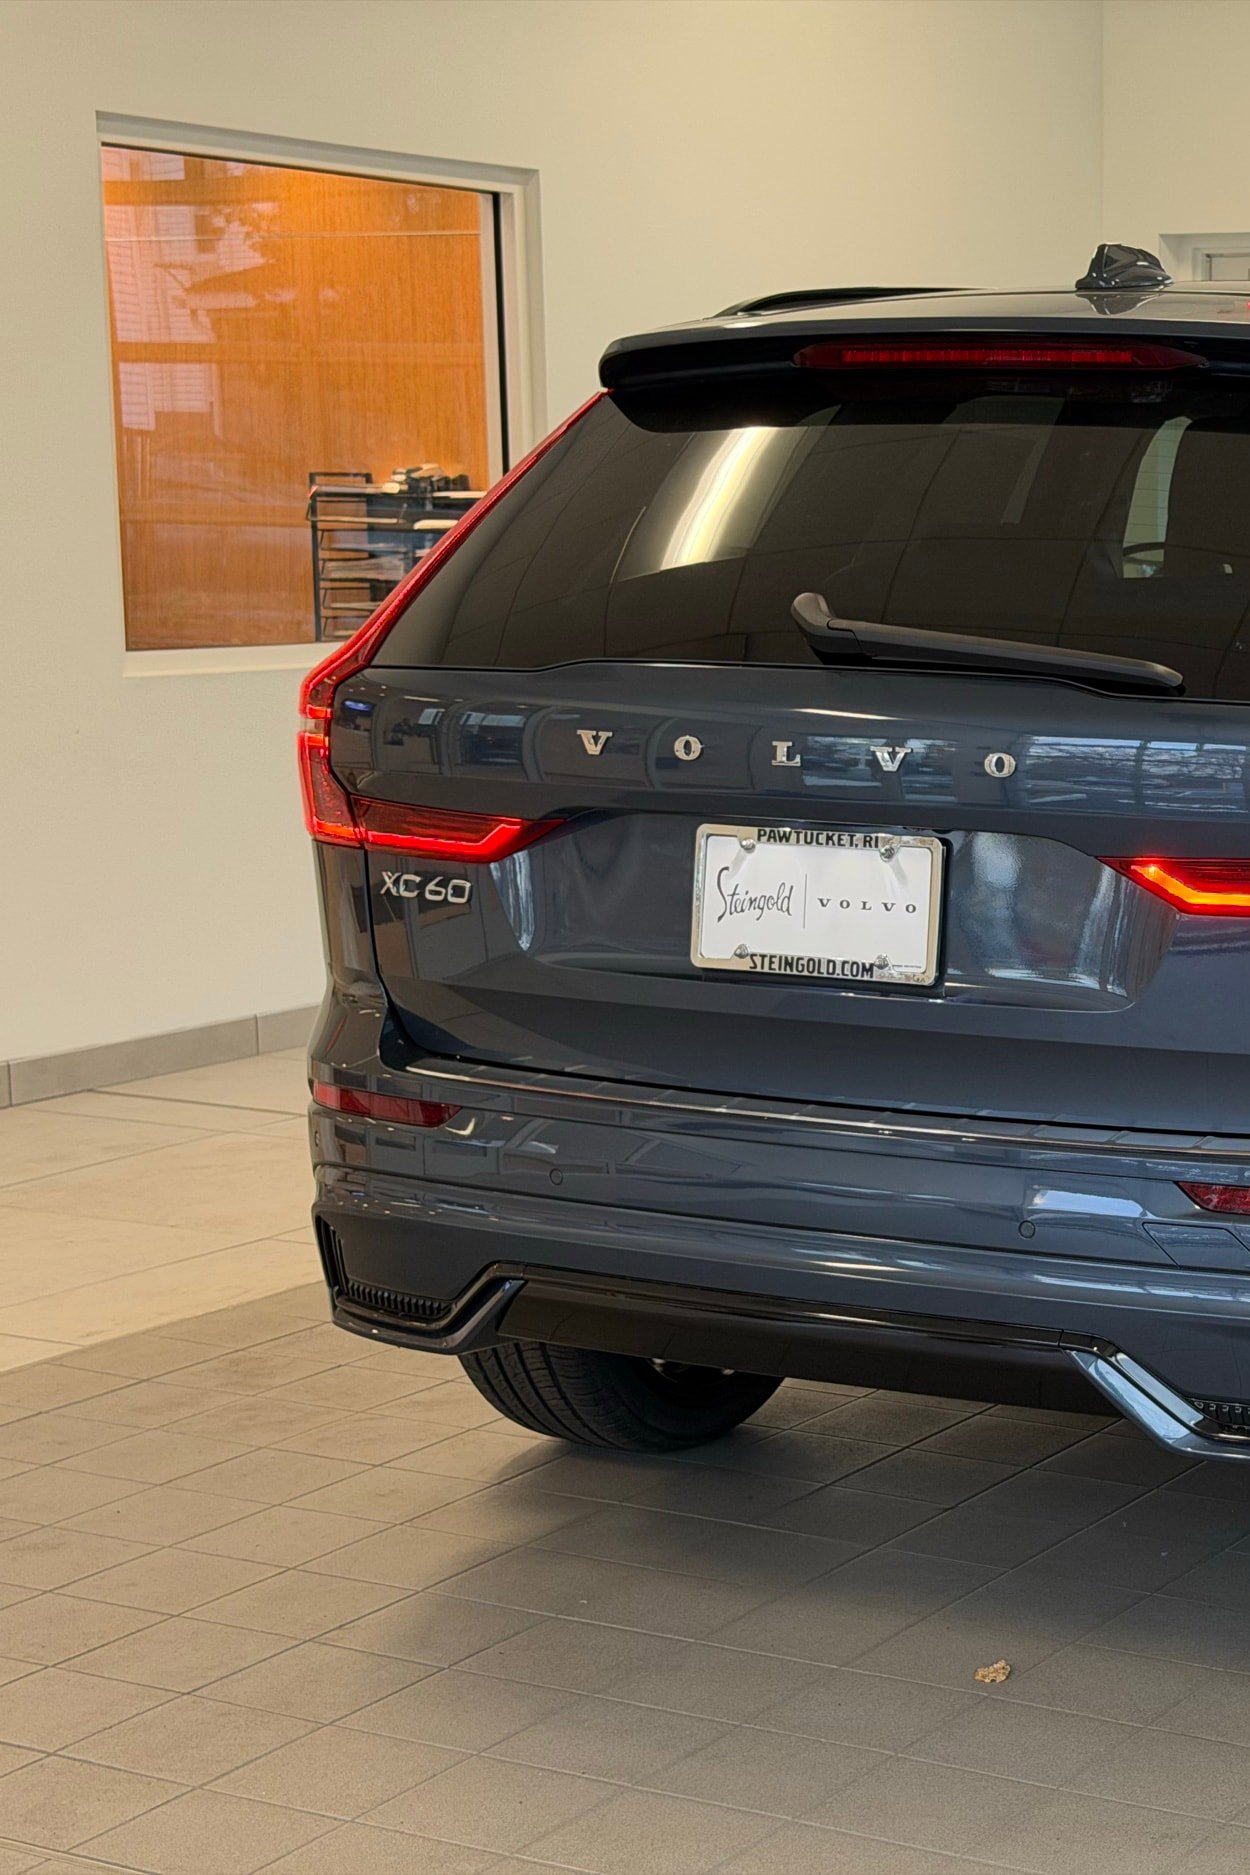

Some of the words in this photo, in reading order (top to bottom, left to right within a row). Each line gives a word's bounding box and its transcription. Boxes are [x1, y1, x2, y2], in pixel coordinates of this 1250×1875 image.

[577, 729, 1016, 778] VOLVO
[757, 828, 859, 848] PAWTUCKET,
[863, 835, 879, 849] RI
[380, 871, 471, 903] XC60
[717, 866, 794, 923] Steingold
[817, 897, 917, 914] VOLVO
[749, 953, 875, 979] STEINGOLD.COM
